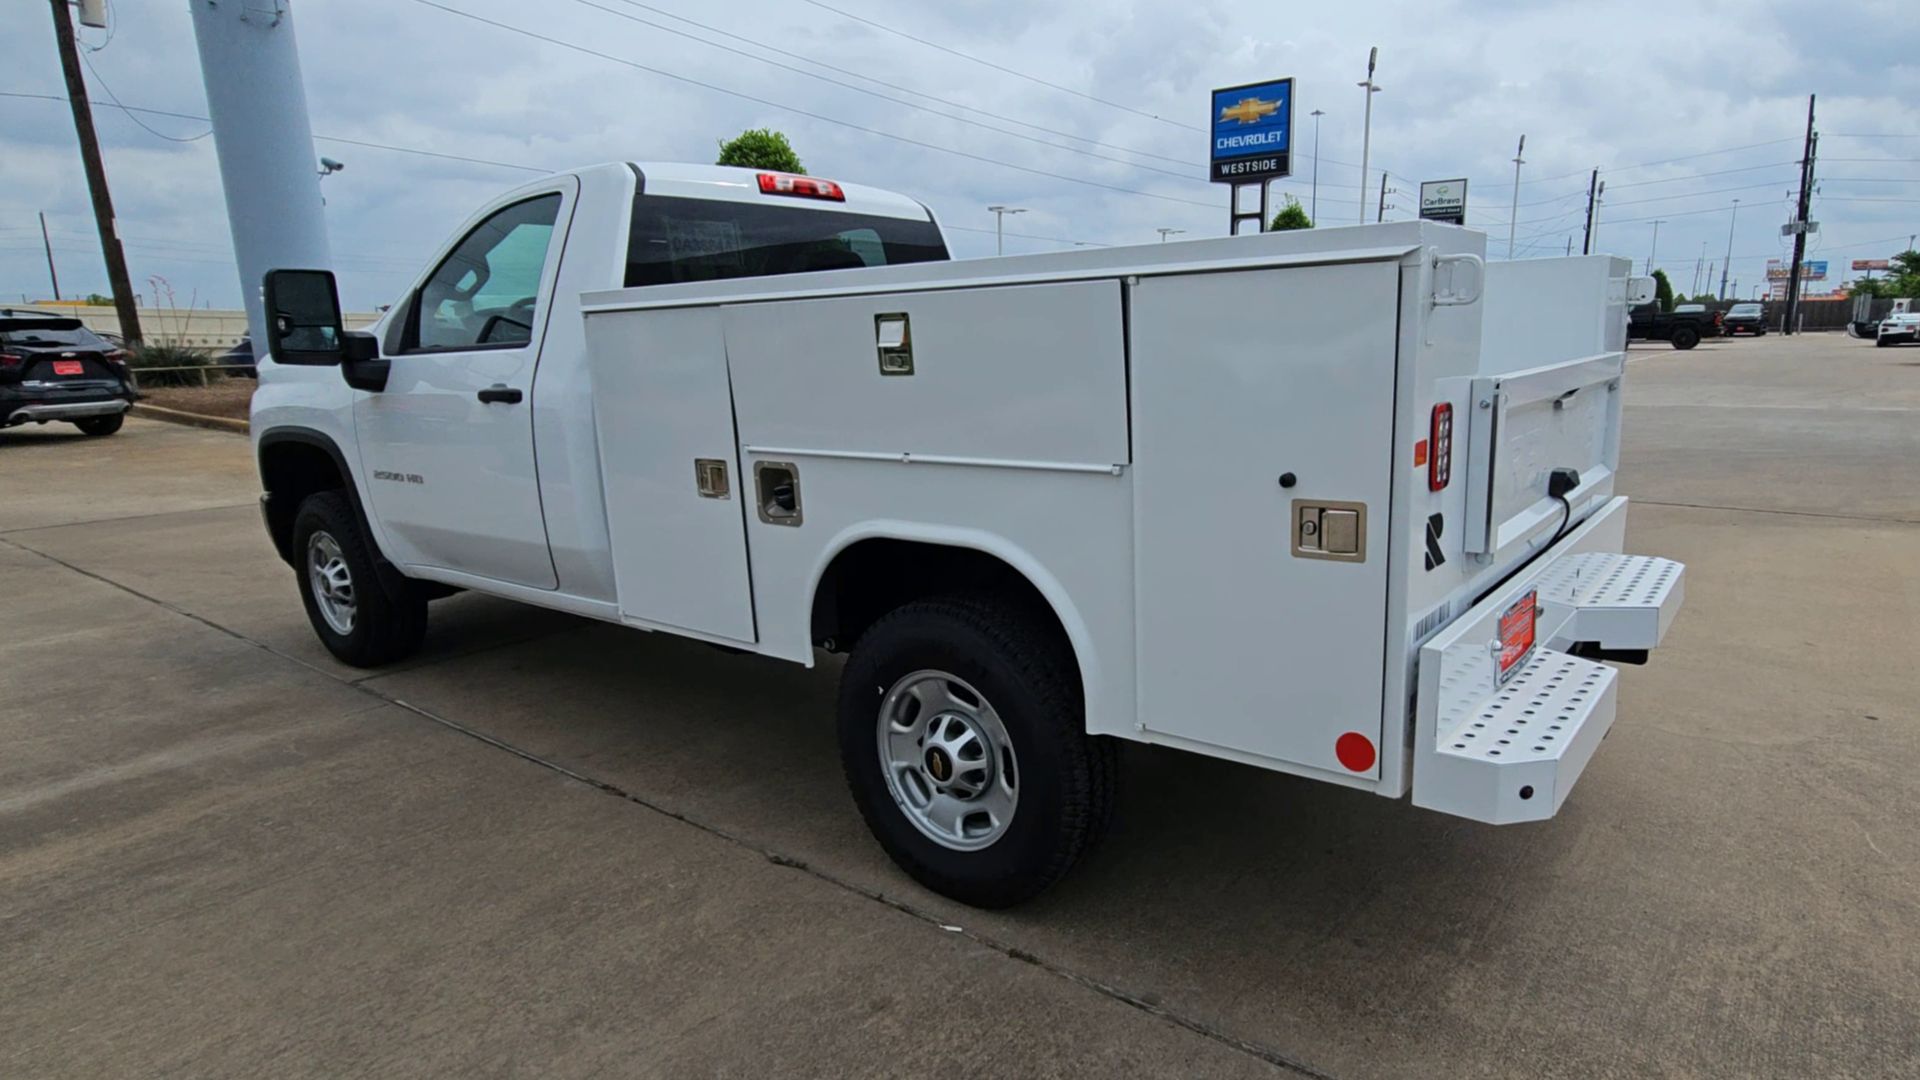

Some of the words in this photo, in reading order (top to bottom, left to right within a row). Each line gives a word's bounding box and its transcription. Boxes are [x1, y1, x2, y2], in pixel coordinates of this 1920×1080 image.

[1217, 131, 1282, 149] CHEVROLET
[1221, 159, 1277, 174] WESTSIDE
[1424, 197, 1460, 206] CarBravo
